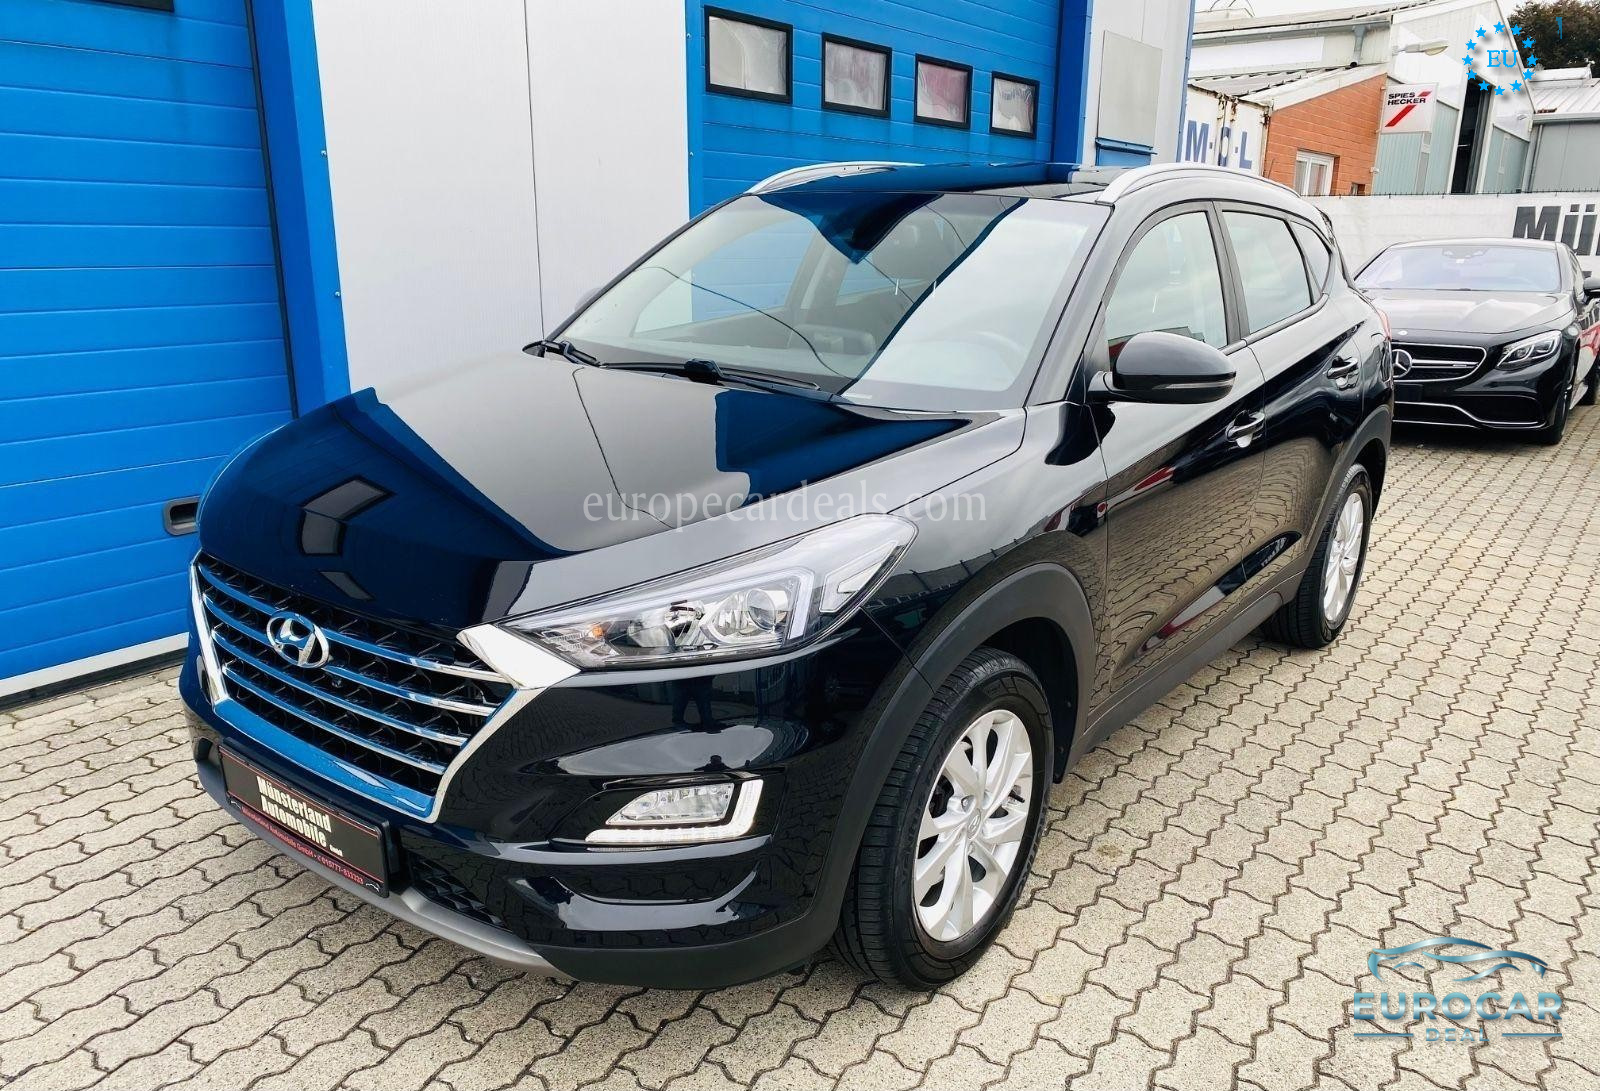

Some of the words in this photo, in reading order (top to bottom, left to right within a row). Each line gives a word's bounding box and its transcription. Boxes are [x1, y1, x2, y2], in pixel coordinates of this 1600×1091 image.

[1387, 98, 1427, 106] HECKER
[1388, 92, 1416, 100] SPIES
[1512, 203, 1600, 256] Mü
[256, 775, 332, 833] Münsterland
[260, 794, 327, 848] Automobile
